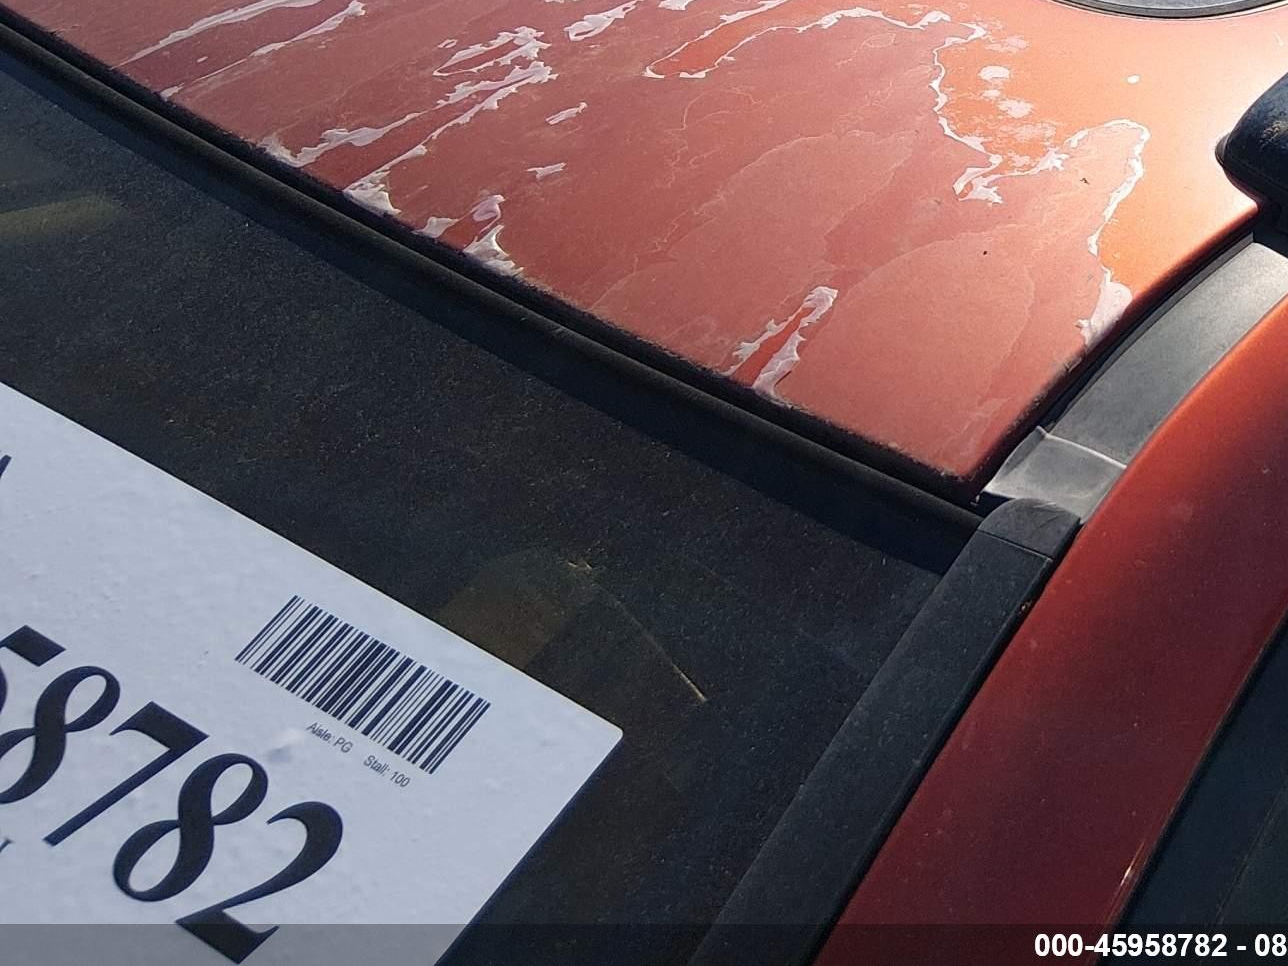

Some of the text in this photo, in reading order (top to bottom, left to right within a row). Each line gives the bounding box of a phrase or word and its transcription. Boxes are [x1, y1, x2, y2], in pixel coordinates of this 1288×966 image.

[306, 721, 411, 788] Aisle: PG Stall: 100
